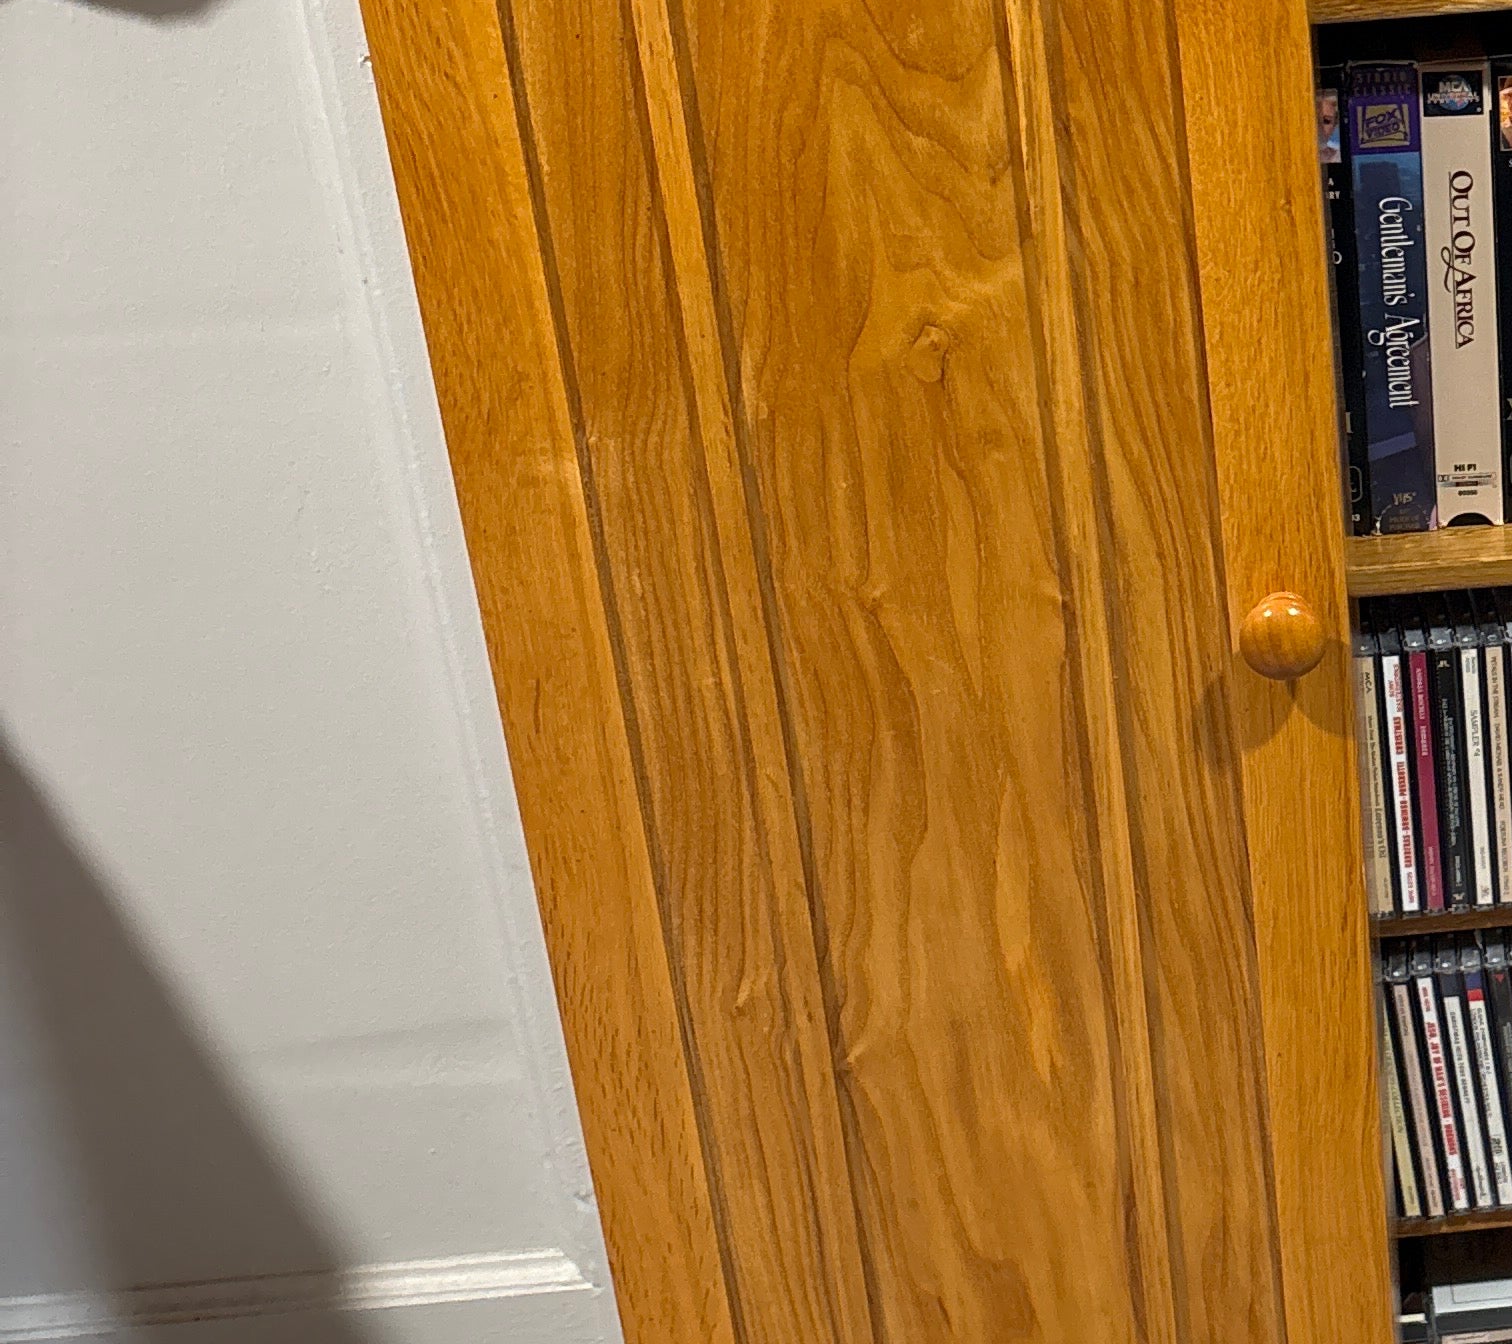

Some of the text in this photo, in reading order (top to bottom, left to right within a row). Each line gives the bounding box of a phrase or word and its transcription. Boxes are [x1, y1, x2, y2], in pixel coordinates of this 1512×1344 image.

[1450, 170, 1474, 227] OUT
[1368, 197, 1421, 409] Gentleman's Agreement
[1453, 272, 1475, 349] AFRICA
